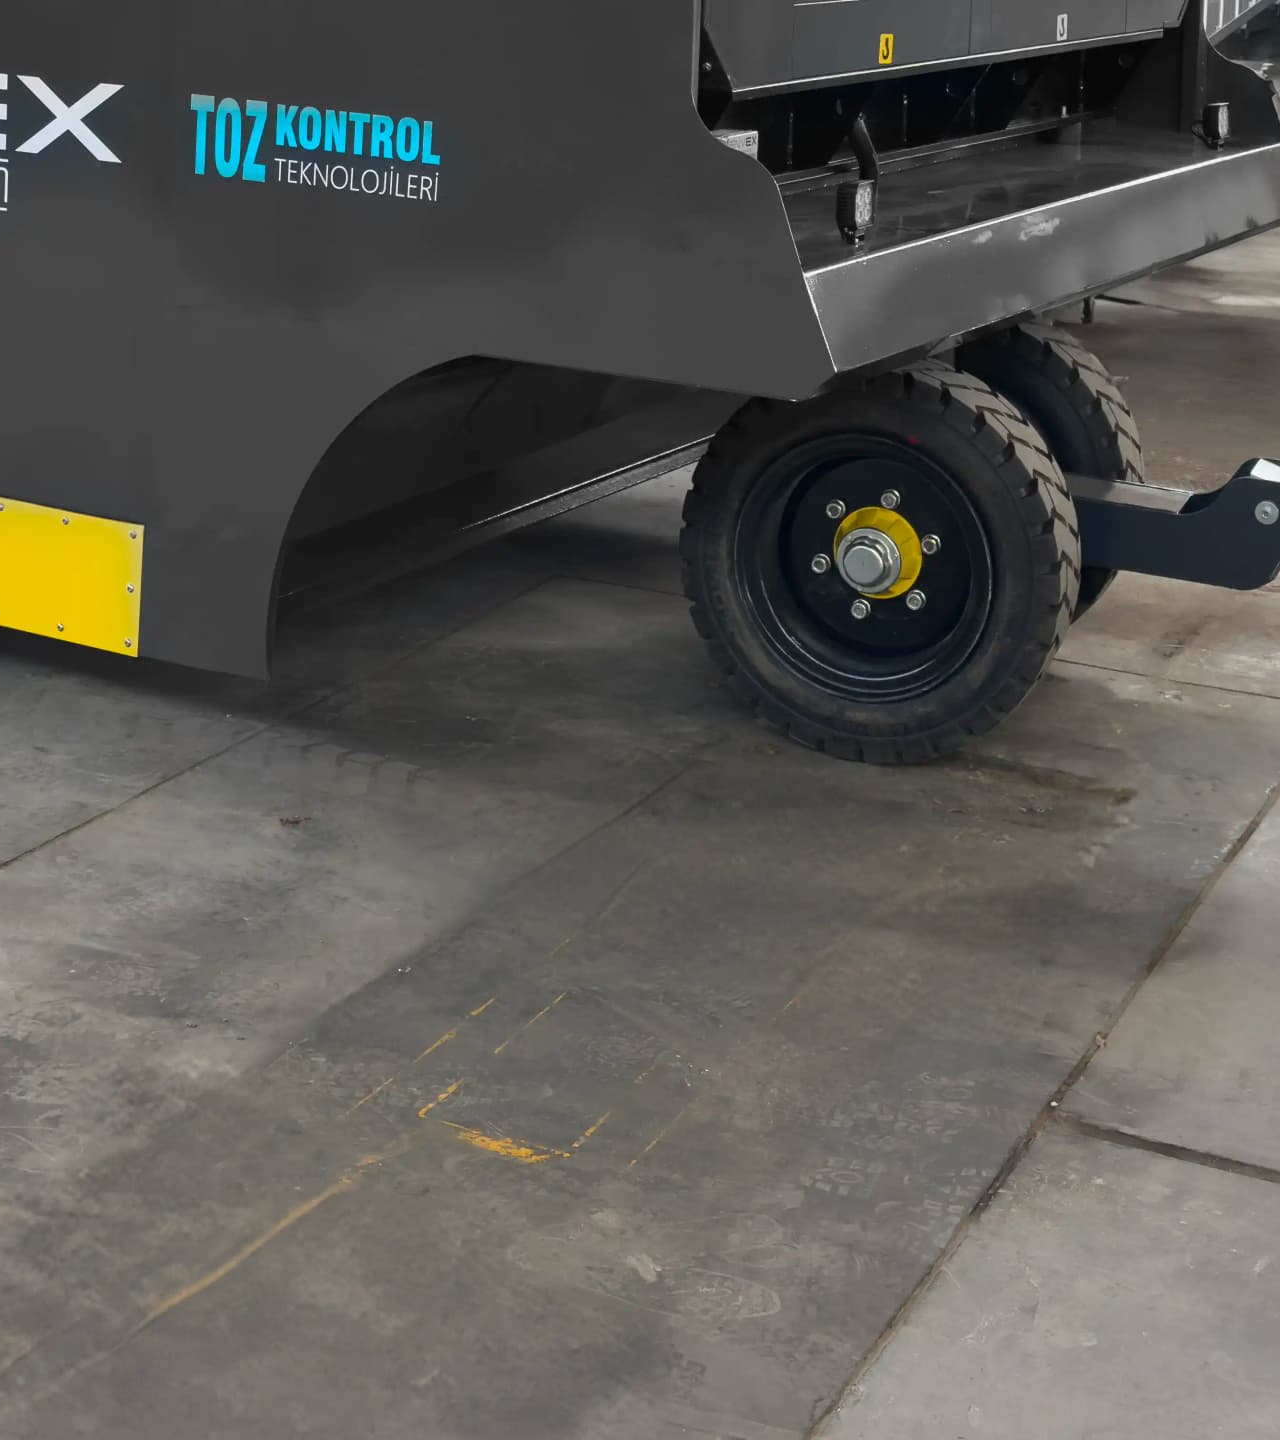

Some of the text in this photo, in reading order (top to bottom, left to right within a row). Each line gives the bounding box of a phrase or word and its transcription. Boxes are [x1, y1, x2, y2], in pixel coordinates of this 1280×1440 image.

[190, 93, 441, 183] TOZ KONTROL
[274, 157, 440, 202] TEKNOLOJİLERİ
